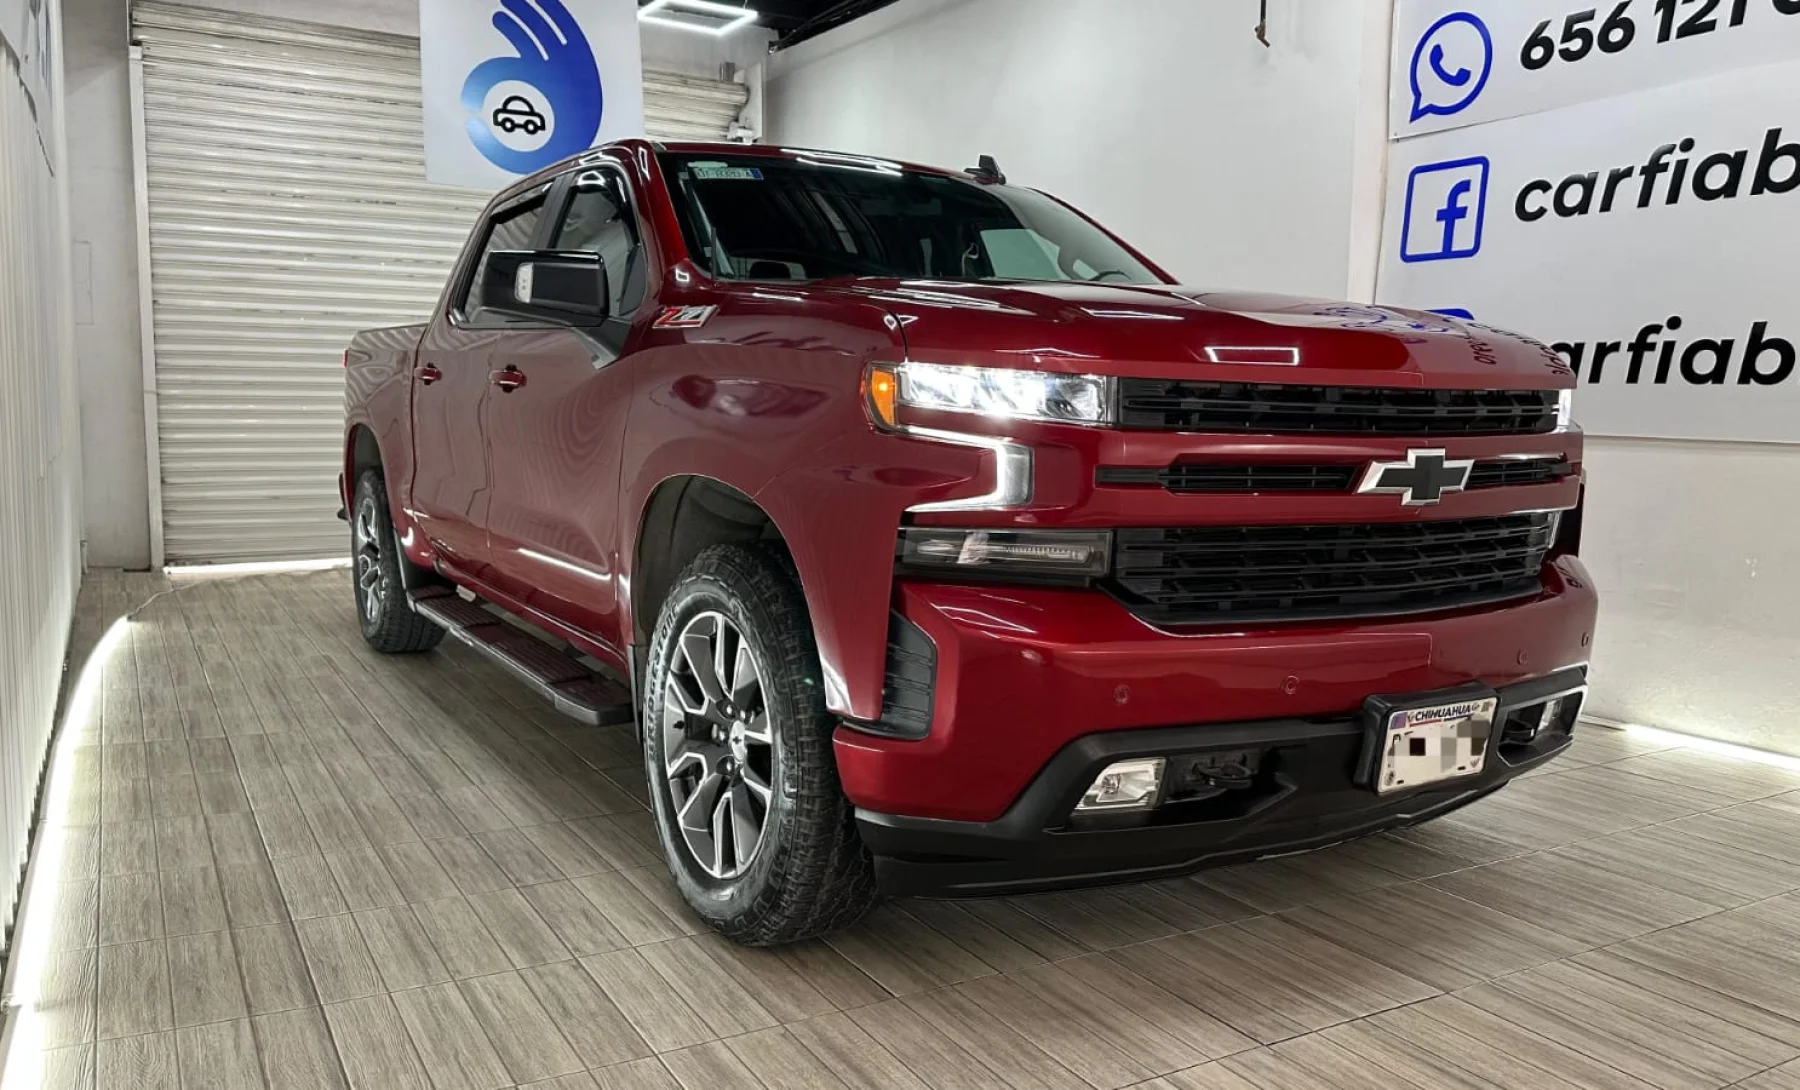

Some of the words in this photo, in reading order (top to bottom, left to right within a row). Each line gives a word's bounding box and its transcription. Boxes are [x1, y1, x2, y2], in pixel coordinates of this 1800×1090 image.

[1520, 0, 1636, 71] 656
[1515, 127, 1800, 222] carfiab
[1549, 315, 1796, 386] arfiab
[1415, 704, 1471, 721] CHIHUAHUA
